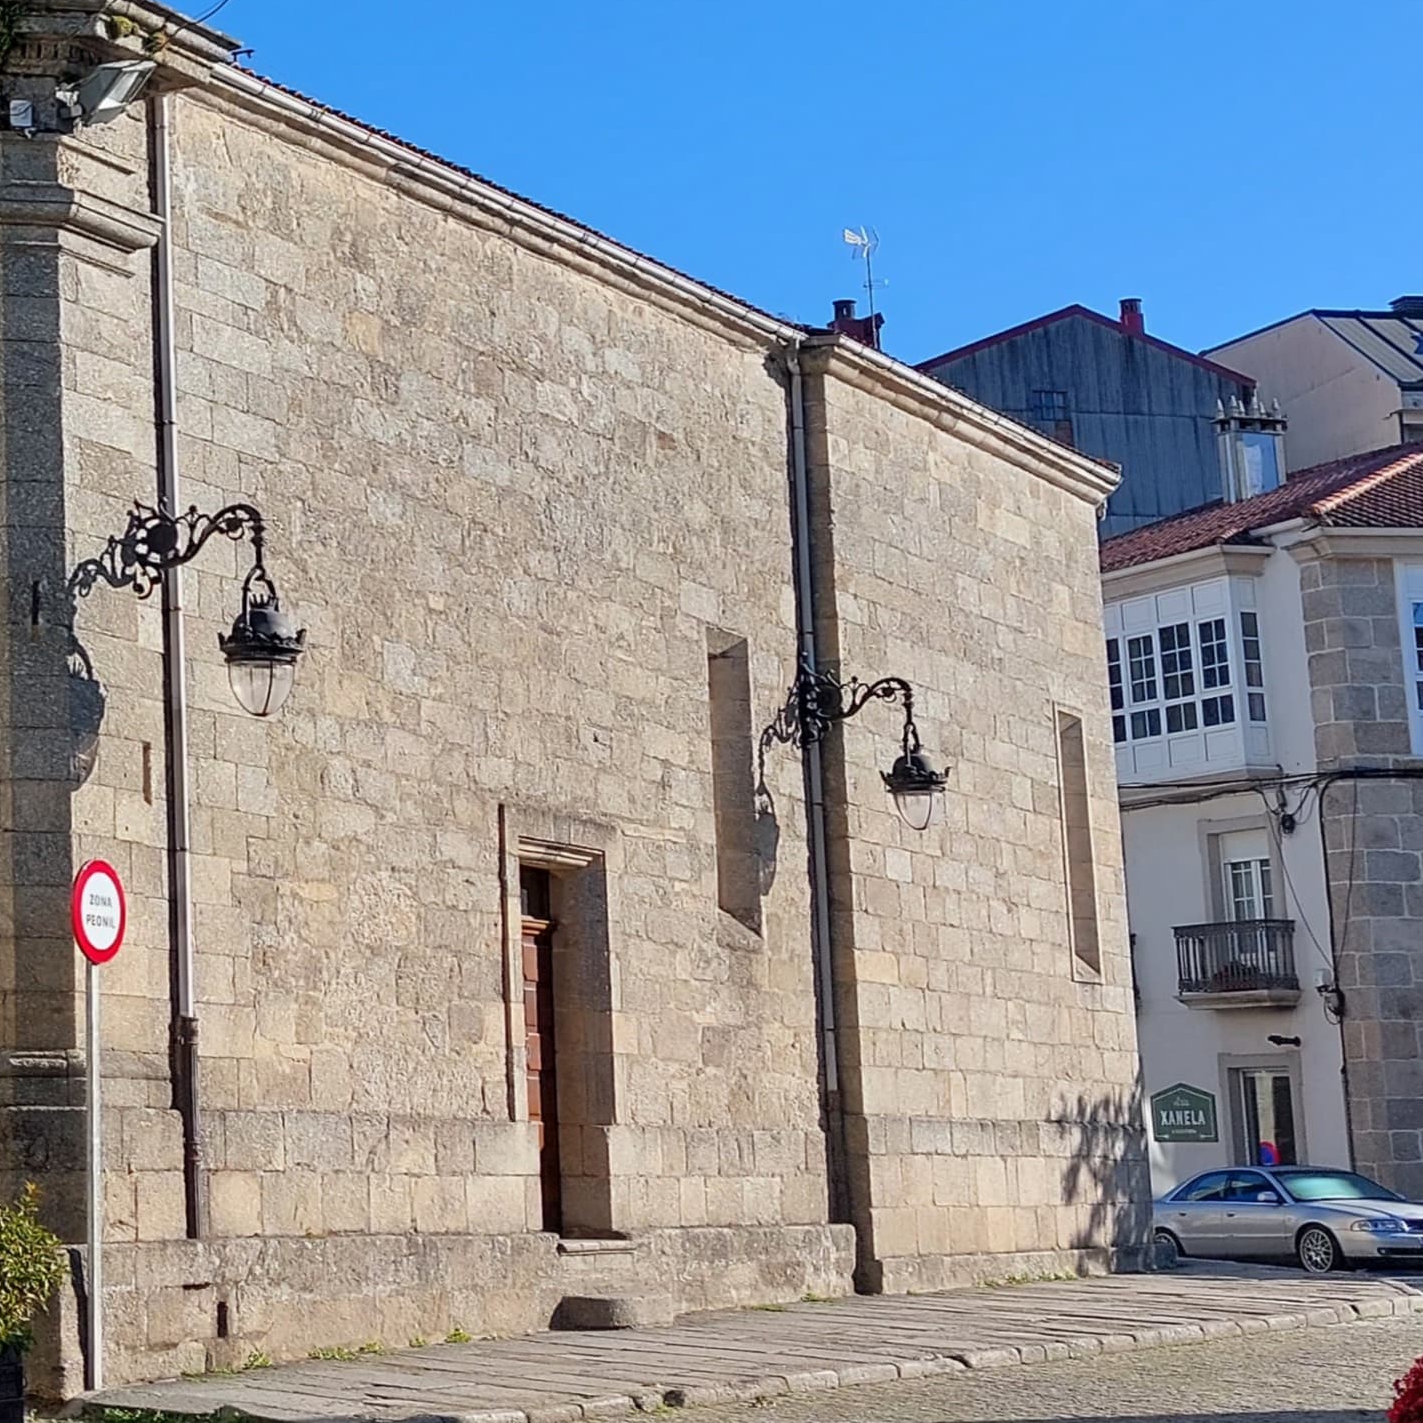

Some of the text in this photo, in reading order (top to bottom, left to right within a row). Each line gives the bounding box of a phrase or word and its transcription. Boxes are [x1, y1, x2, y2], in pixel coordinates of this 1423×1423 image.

[89, 893, 113, 908] ZONA
[86, 913, 116, 929] PEONIL
[1160, 1109, 1207, 1126] XANELA
